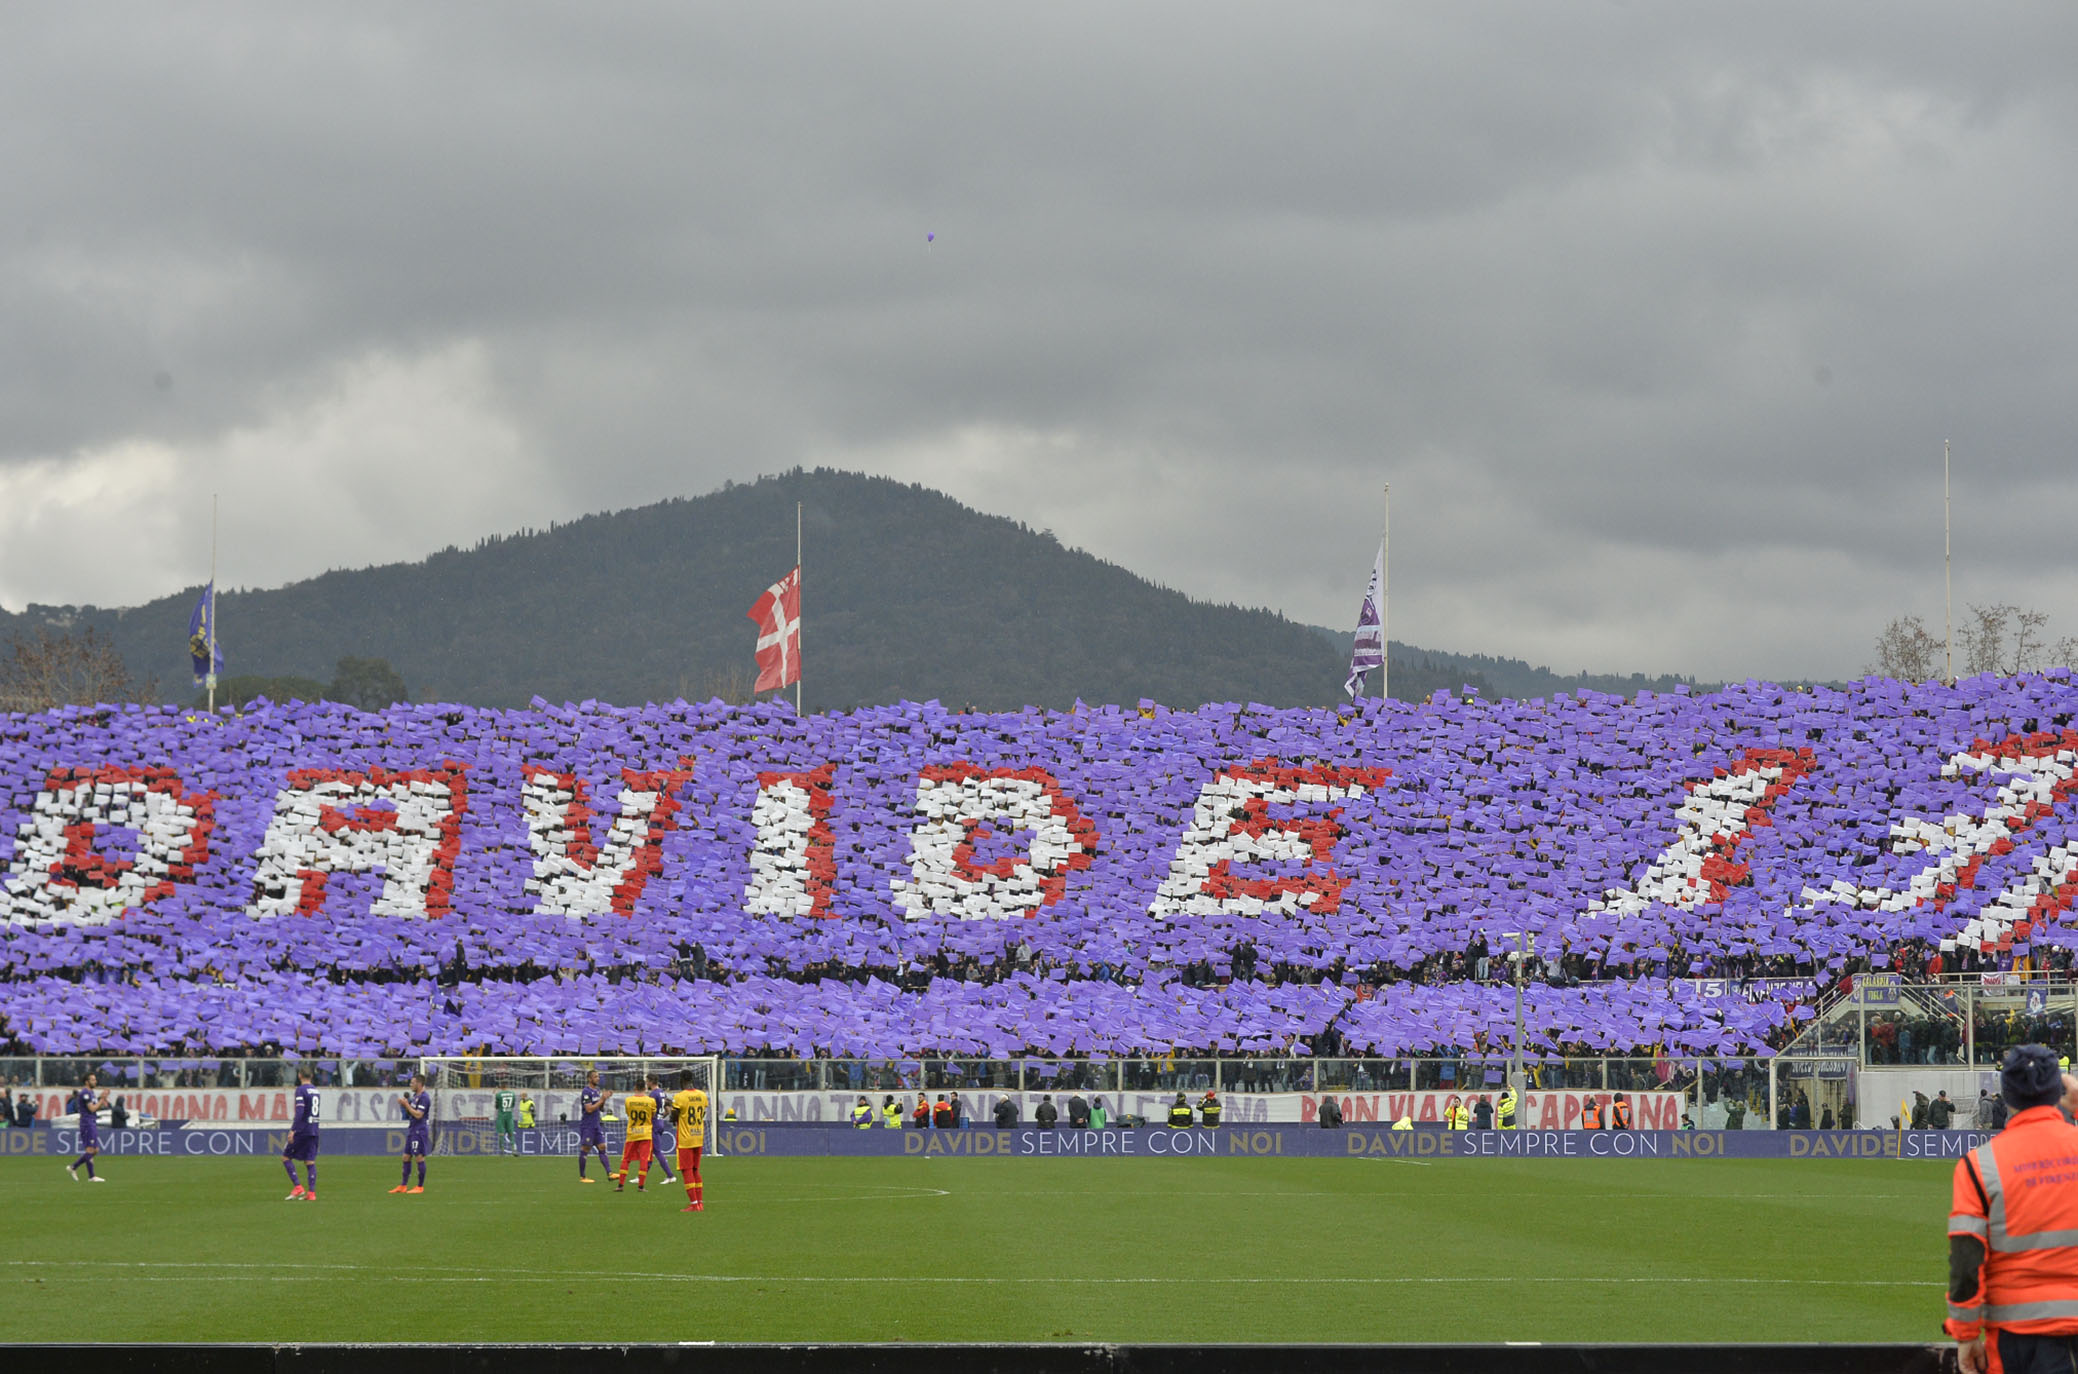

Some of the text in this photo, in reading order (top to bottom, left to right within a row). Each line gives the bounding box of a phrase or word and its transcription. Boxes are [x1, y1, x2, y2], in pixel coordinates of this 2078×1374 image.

[0, 757, 1392, 928] DAVIDE
[311, 1095, 320, 1117] 8
[687, 1105, 704, 1126] 83
[630, 1109, 647, 1126] 99
[184, 1132, 254, 1154] CON
[904, 1131, 1282, 1154] DAVIDE SEMPRE CON NOI
[1347, 1132, 1724, 1155] DAVIDE SEMPRE CON NOI
[1789, 1134, 1897, 1156] DAVIDE
